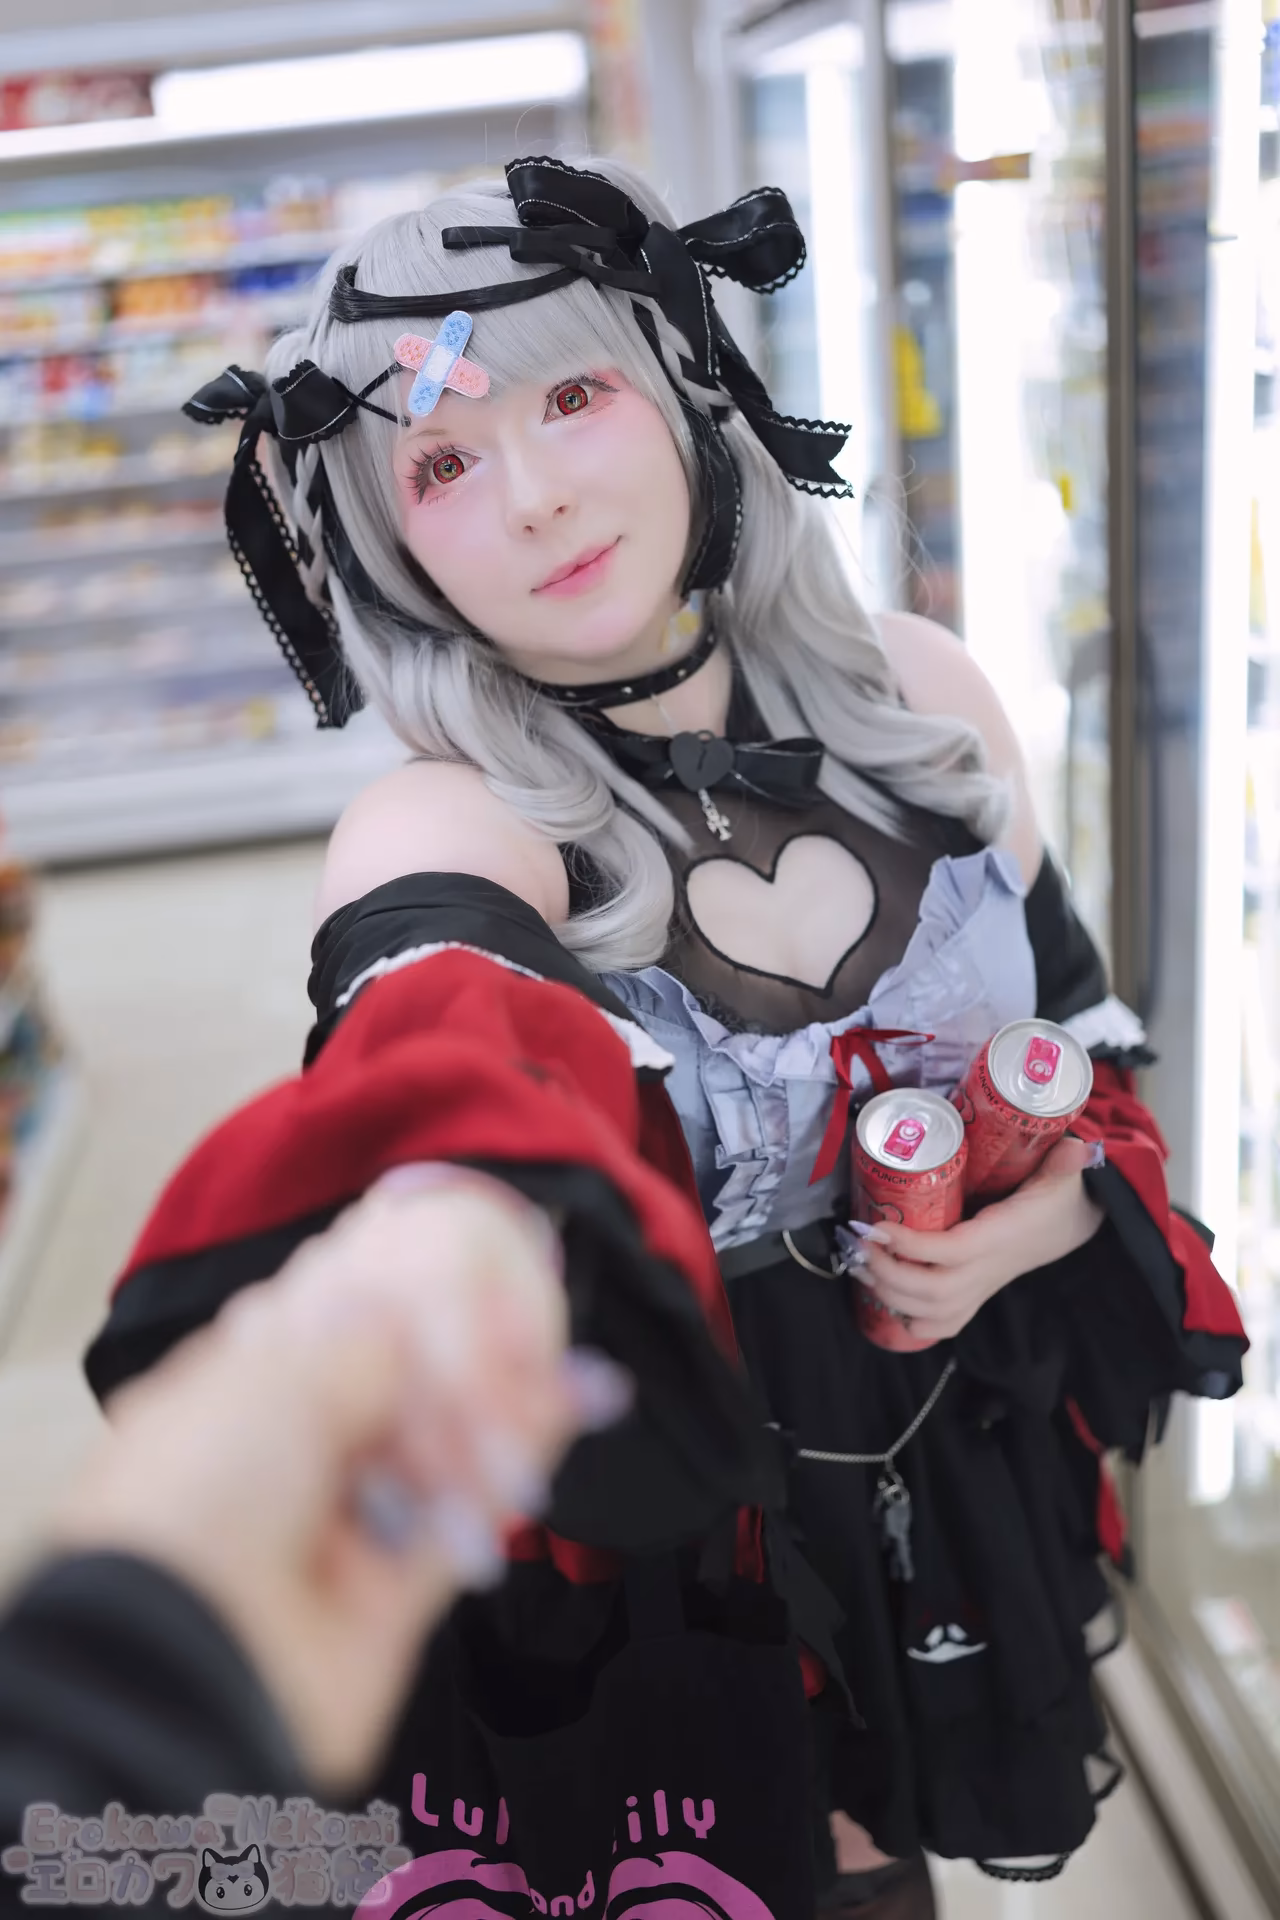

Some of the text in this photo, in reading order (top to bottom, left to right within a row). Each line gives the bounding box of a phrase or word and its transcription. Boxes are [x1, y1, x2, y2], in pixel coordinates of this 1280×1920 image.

[977, 1065, 995, 1102] PUNCH
[871, 1167, 907, 1185] PUNCH
[612, 1789, 716, 1854] ily
[529, 1870, 595, 1917] and
